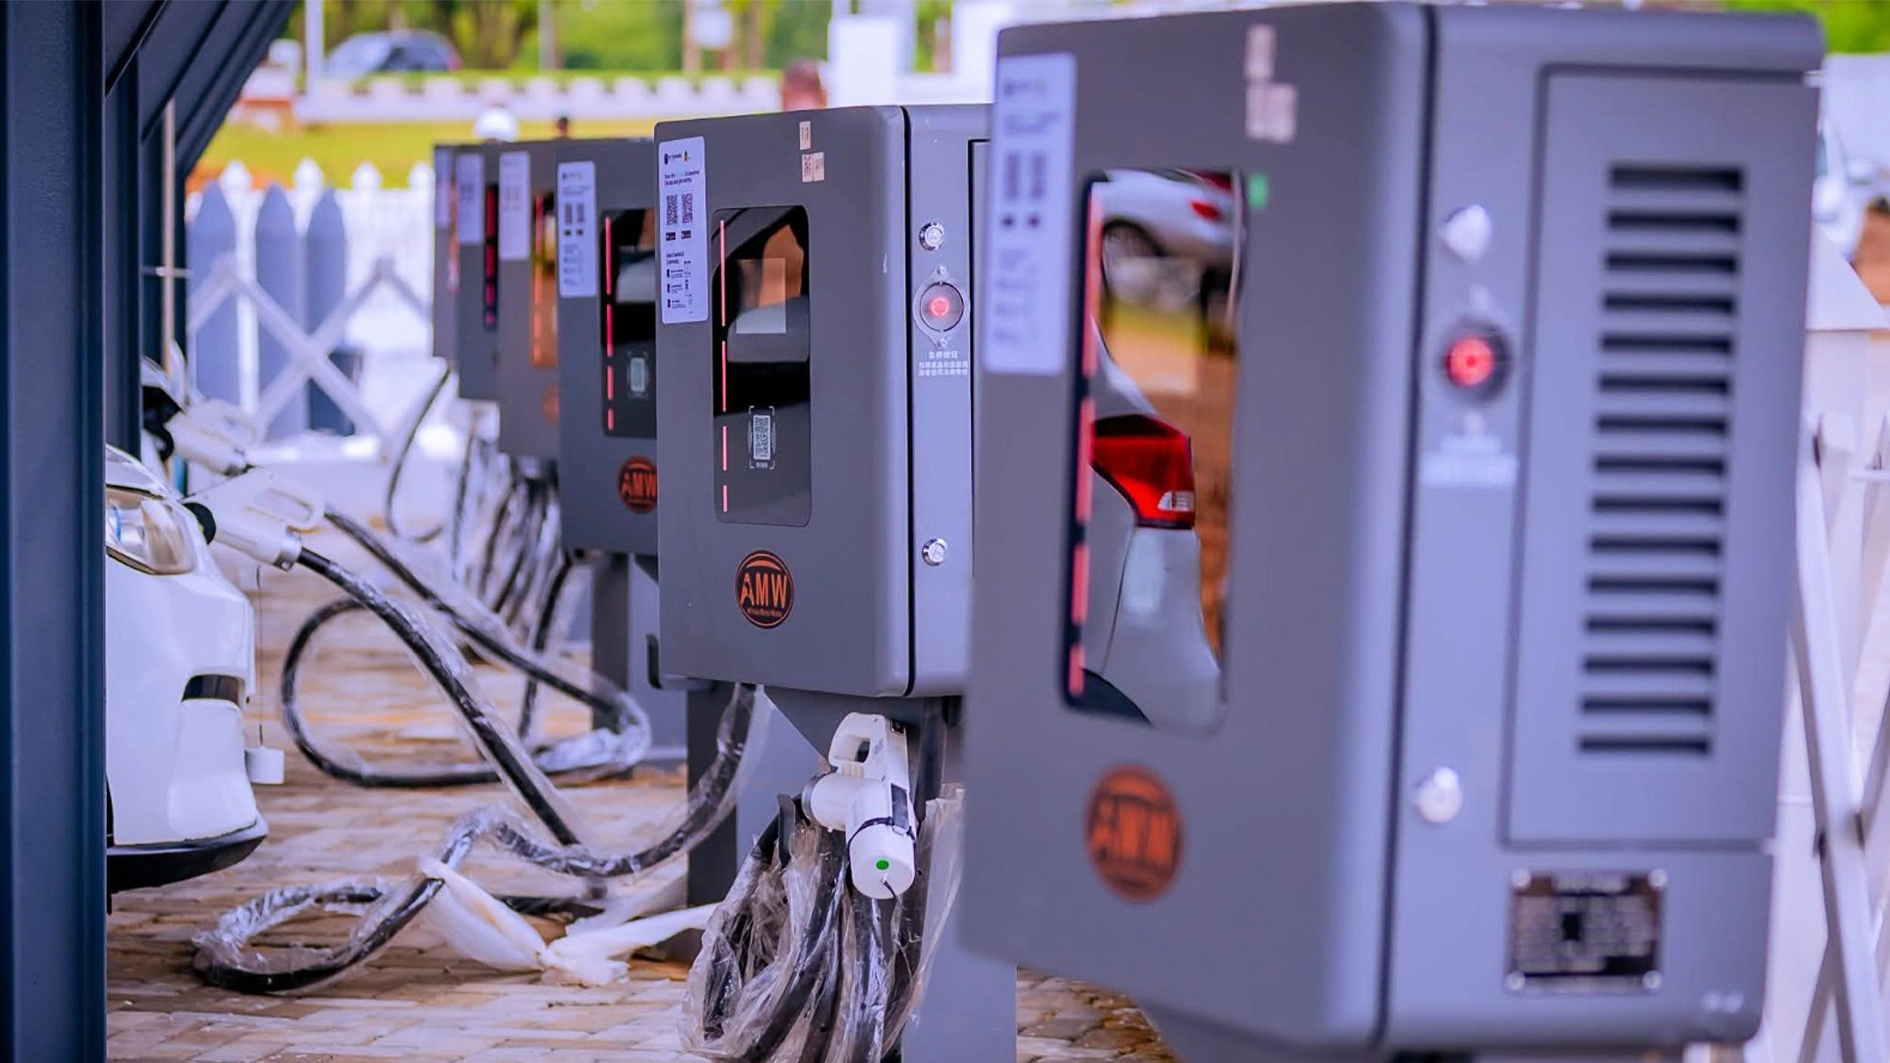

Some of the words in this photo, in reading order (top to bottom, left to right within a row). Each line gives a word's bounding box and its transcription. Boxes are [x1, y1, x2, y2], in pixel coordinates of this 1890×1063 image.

[621, 471, 658, 498] AMW
[740, 571, 788, 609] AMW
[1091, 798, 1174, 866] AMW
